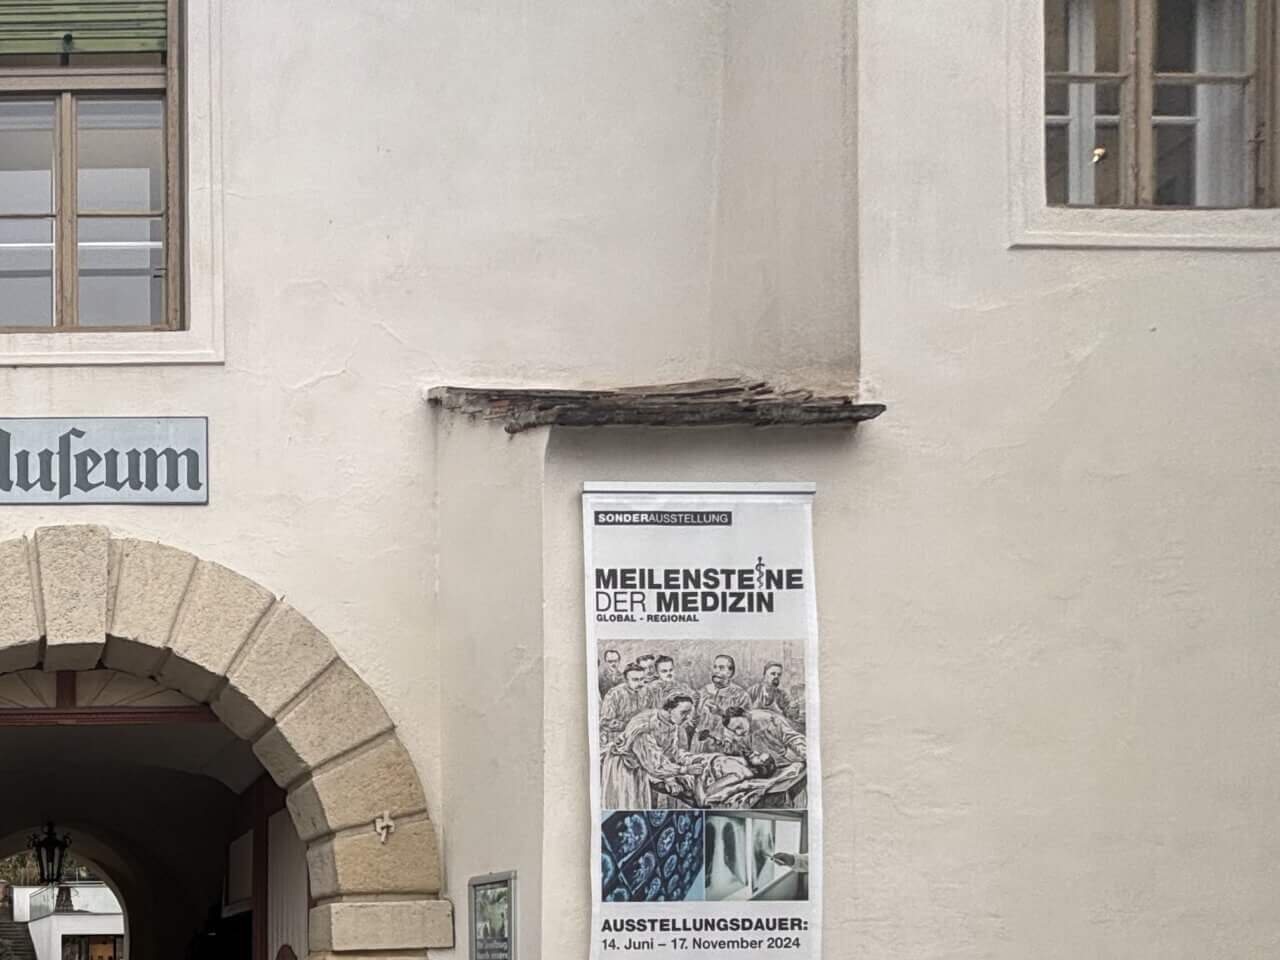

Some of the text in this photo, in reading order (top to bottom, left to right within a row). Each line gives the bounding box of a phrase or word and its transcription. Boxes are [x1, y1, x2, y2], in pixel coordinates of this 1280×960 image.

[597, 512, 729, 525] SONDERAUSSTELLUNG
[595, 591, 775, 613] DER MEDIZIN
[596, 614, 637, 623] GLOBAL
[646, 614, 700, 623] REGIONAL
[600, 918, 809, 932] AUSSTELLUNGSDAUER:
[601, 938, 620, 950] 14.
[624, 937, 654, 950] Juni
[671, 938, 688, 950] 17.
[692, 937, 764, 950] November
[766, 937, 801, 949] 2024
